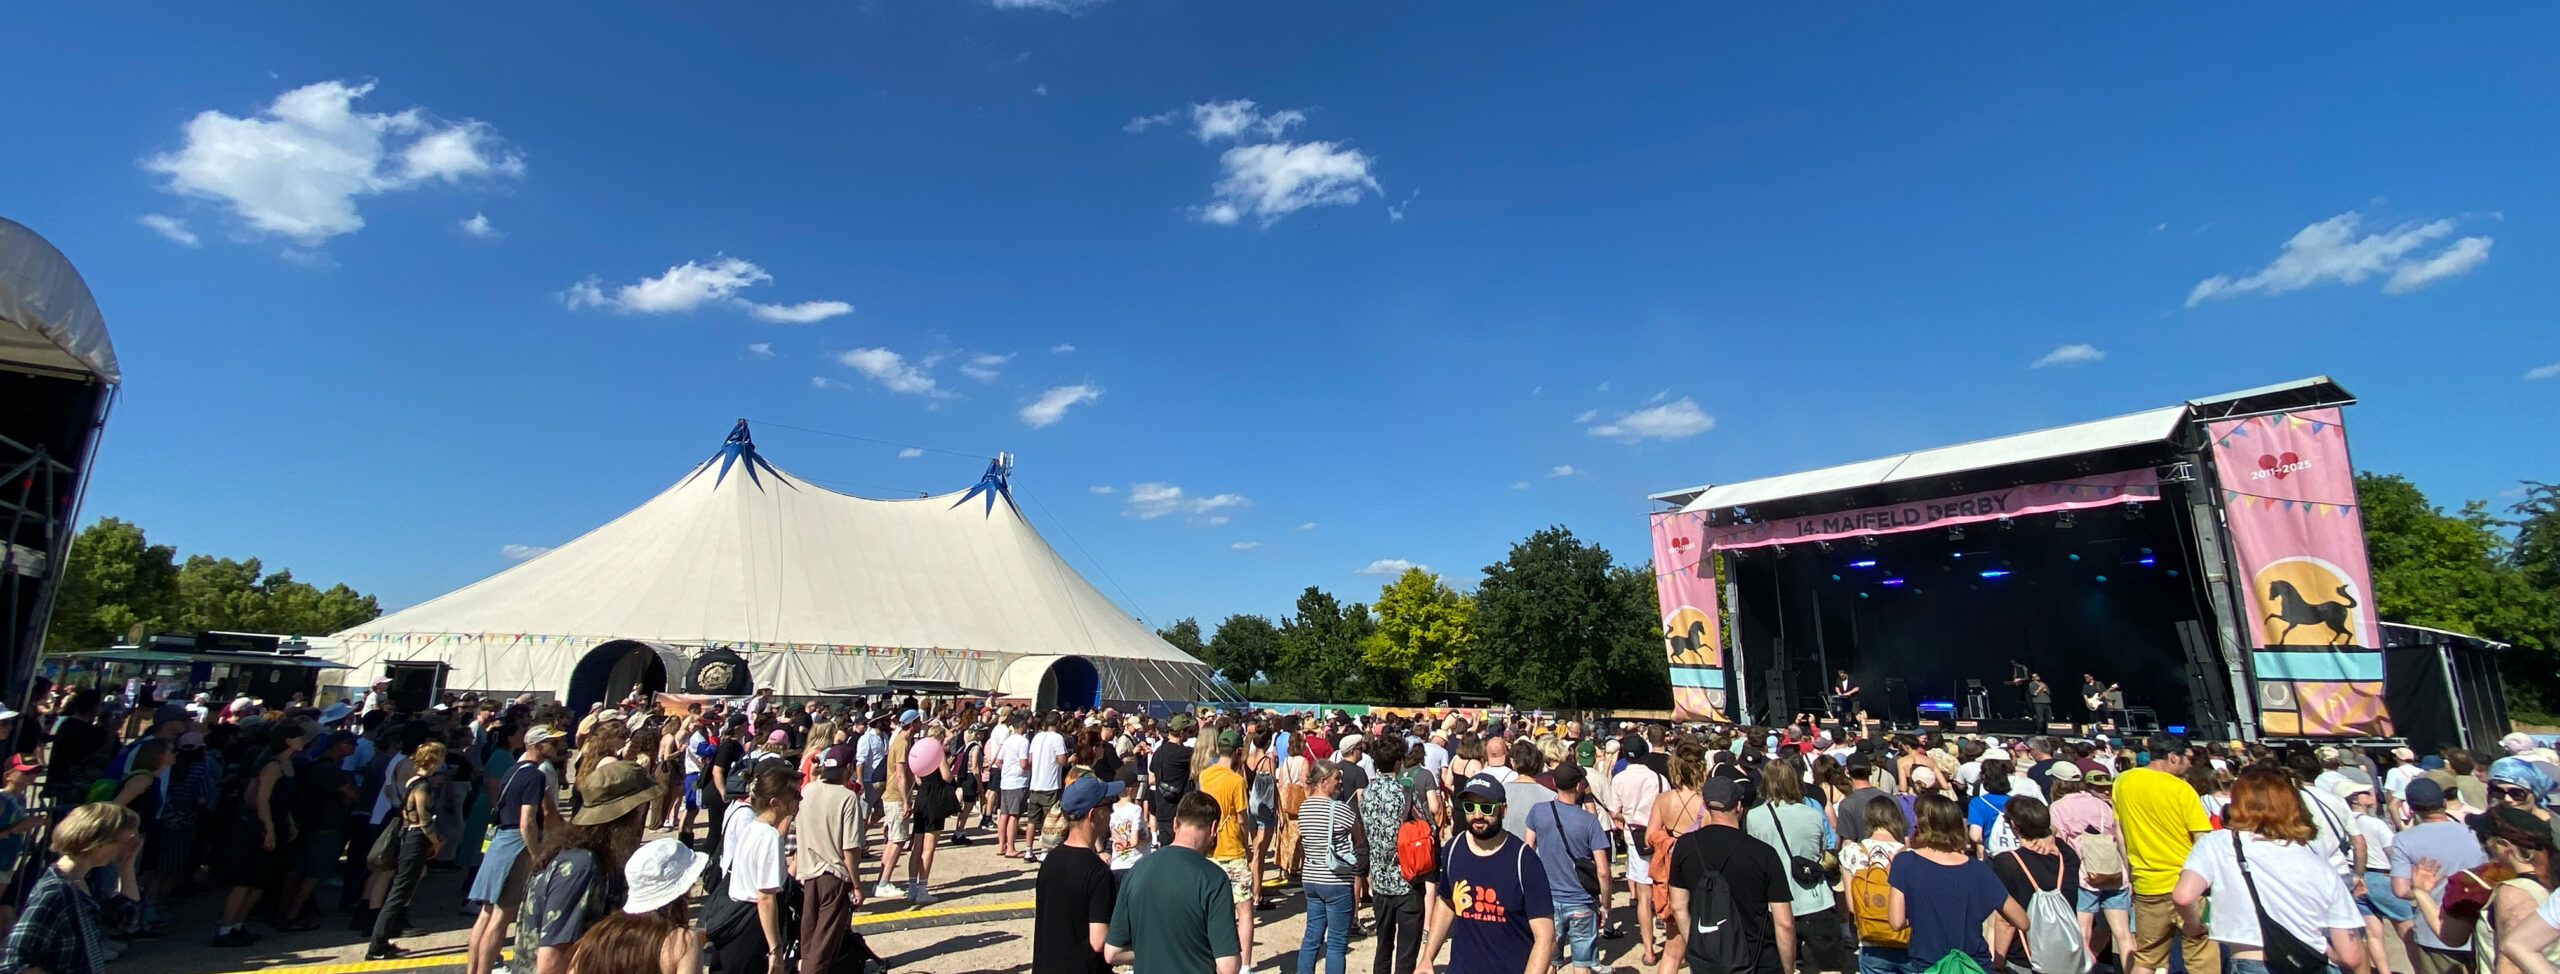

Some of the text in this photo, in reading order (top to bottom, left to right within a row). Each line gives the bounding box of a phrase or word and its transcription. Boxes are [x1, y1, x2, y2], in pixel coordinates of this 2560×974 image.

[1796, 493, 2011, 537] 14. MAIFELD DERBY
